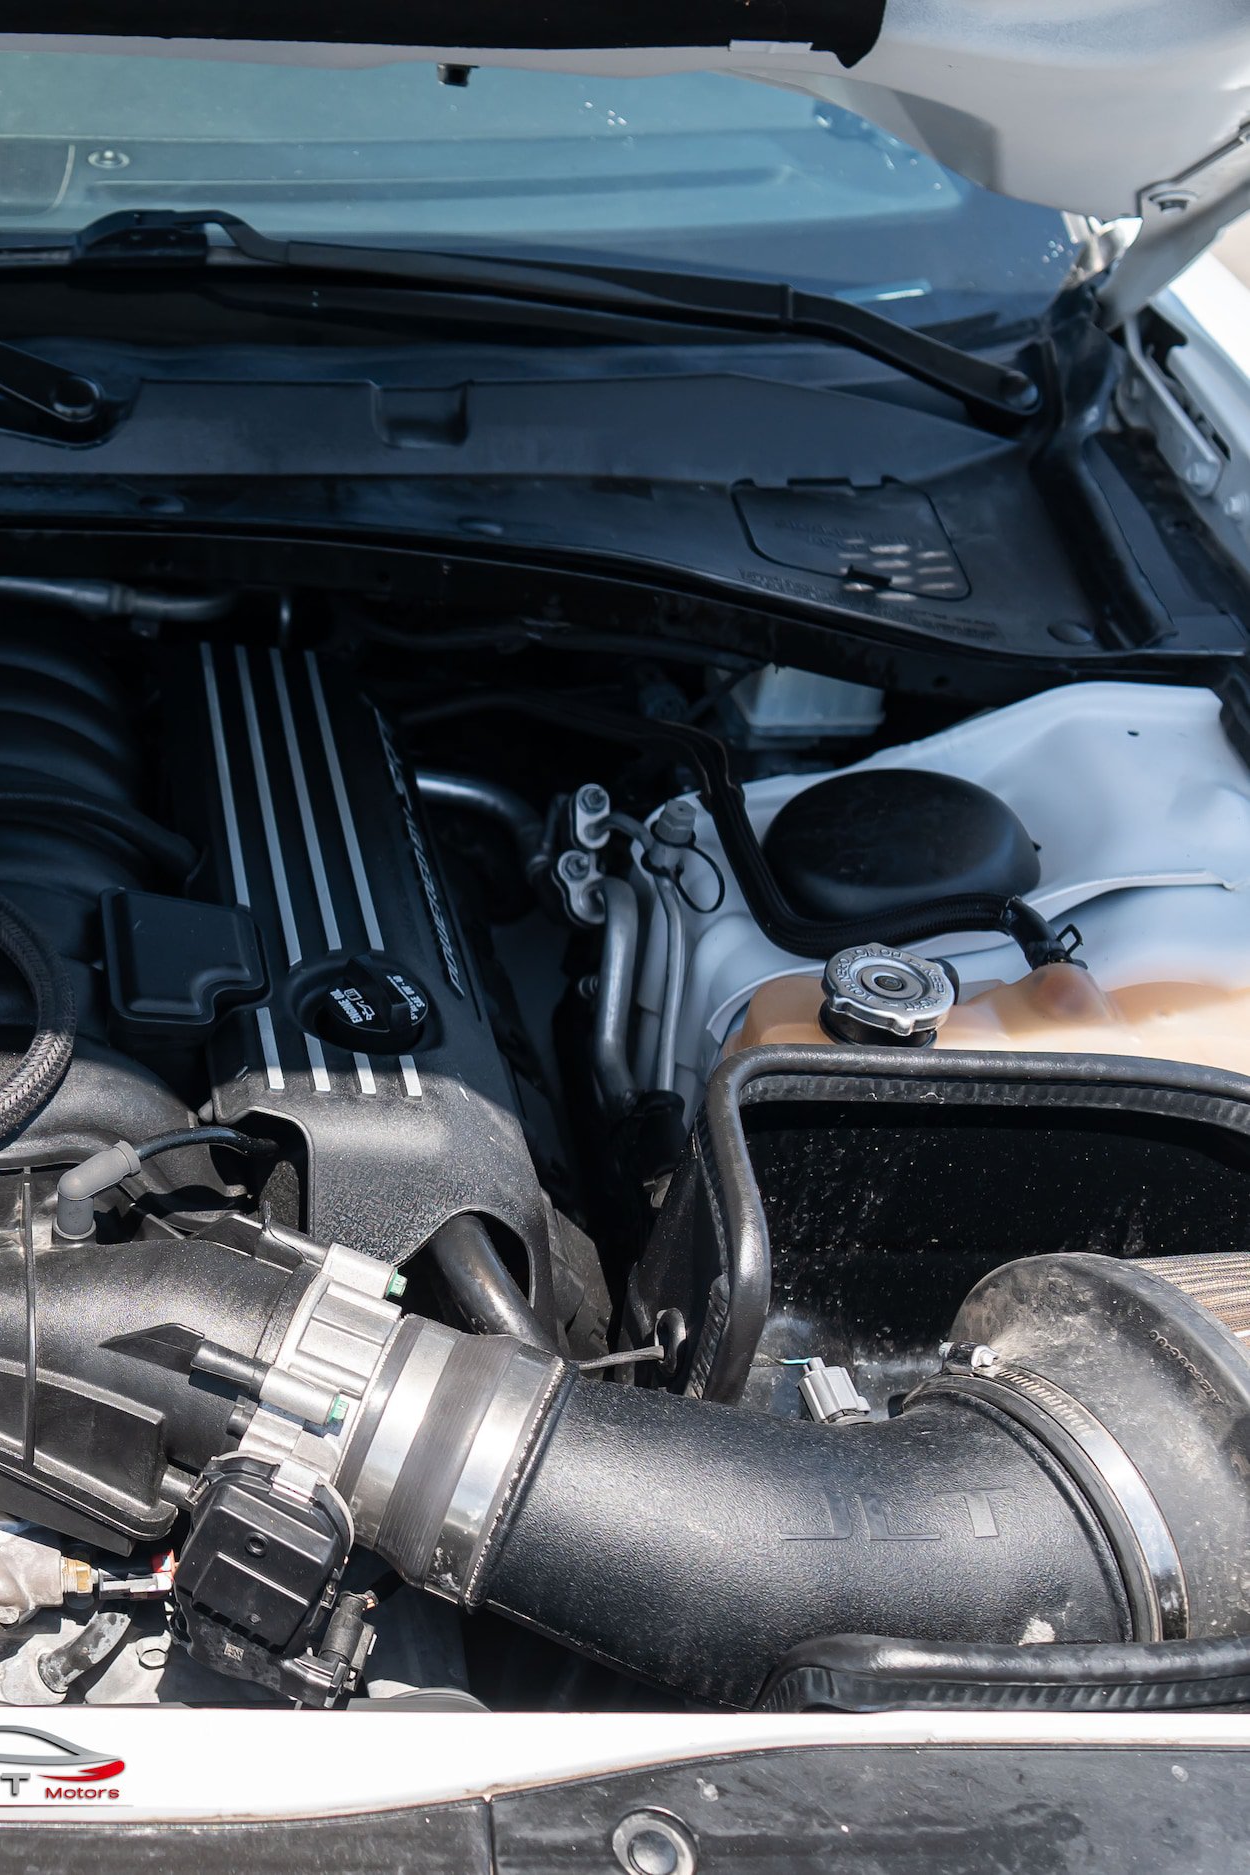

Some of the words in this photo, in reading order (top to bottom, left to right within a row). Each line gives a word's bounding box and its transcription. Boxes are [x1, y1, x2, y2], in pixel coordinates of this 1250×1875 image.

[330, 988, 345, 1000] OIL
[338, 999, 363, 1024] ENGINE
[779, 1486, 1016, 1541] JLT
